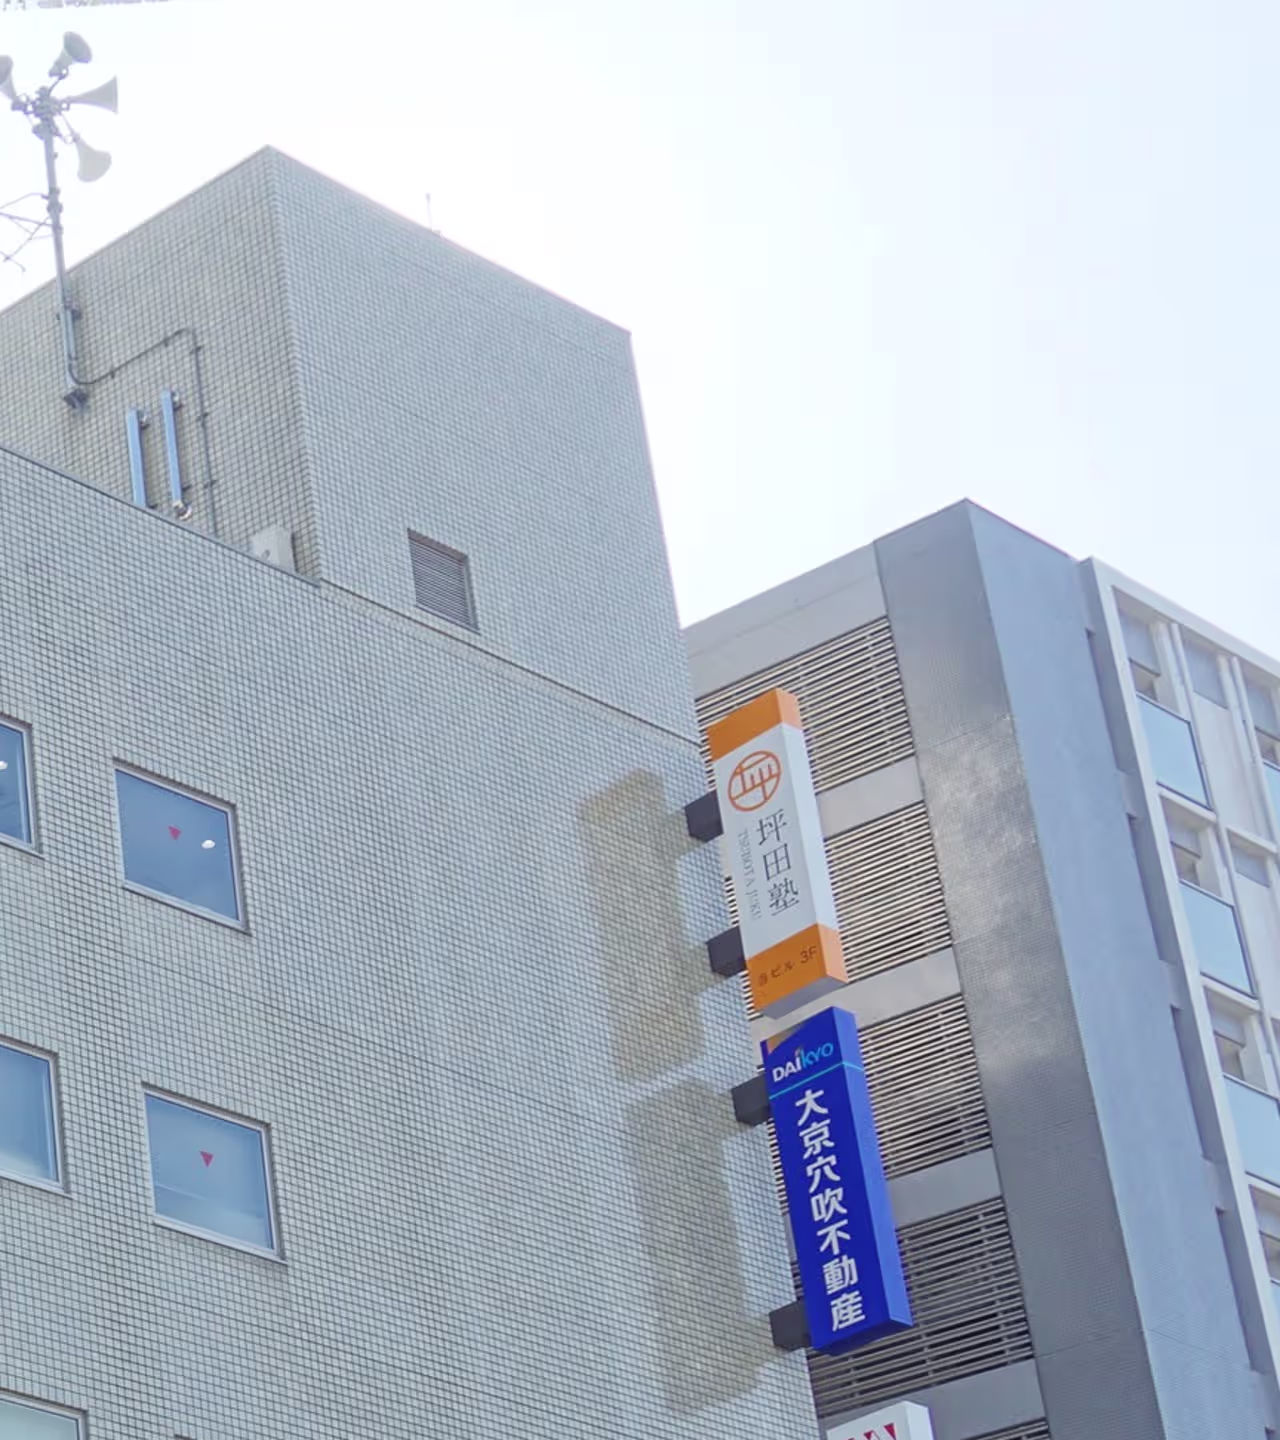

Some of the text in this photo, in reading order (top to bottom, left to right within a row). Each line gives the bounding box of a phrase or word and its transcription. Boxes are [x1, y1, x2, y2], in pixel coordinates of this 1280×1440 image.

[756, 808, 800, 917] 坪田塾
[800, 945, 818, 964] 3F
[795, 1088, 866, 1332] 大京穴吹不動産
